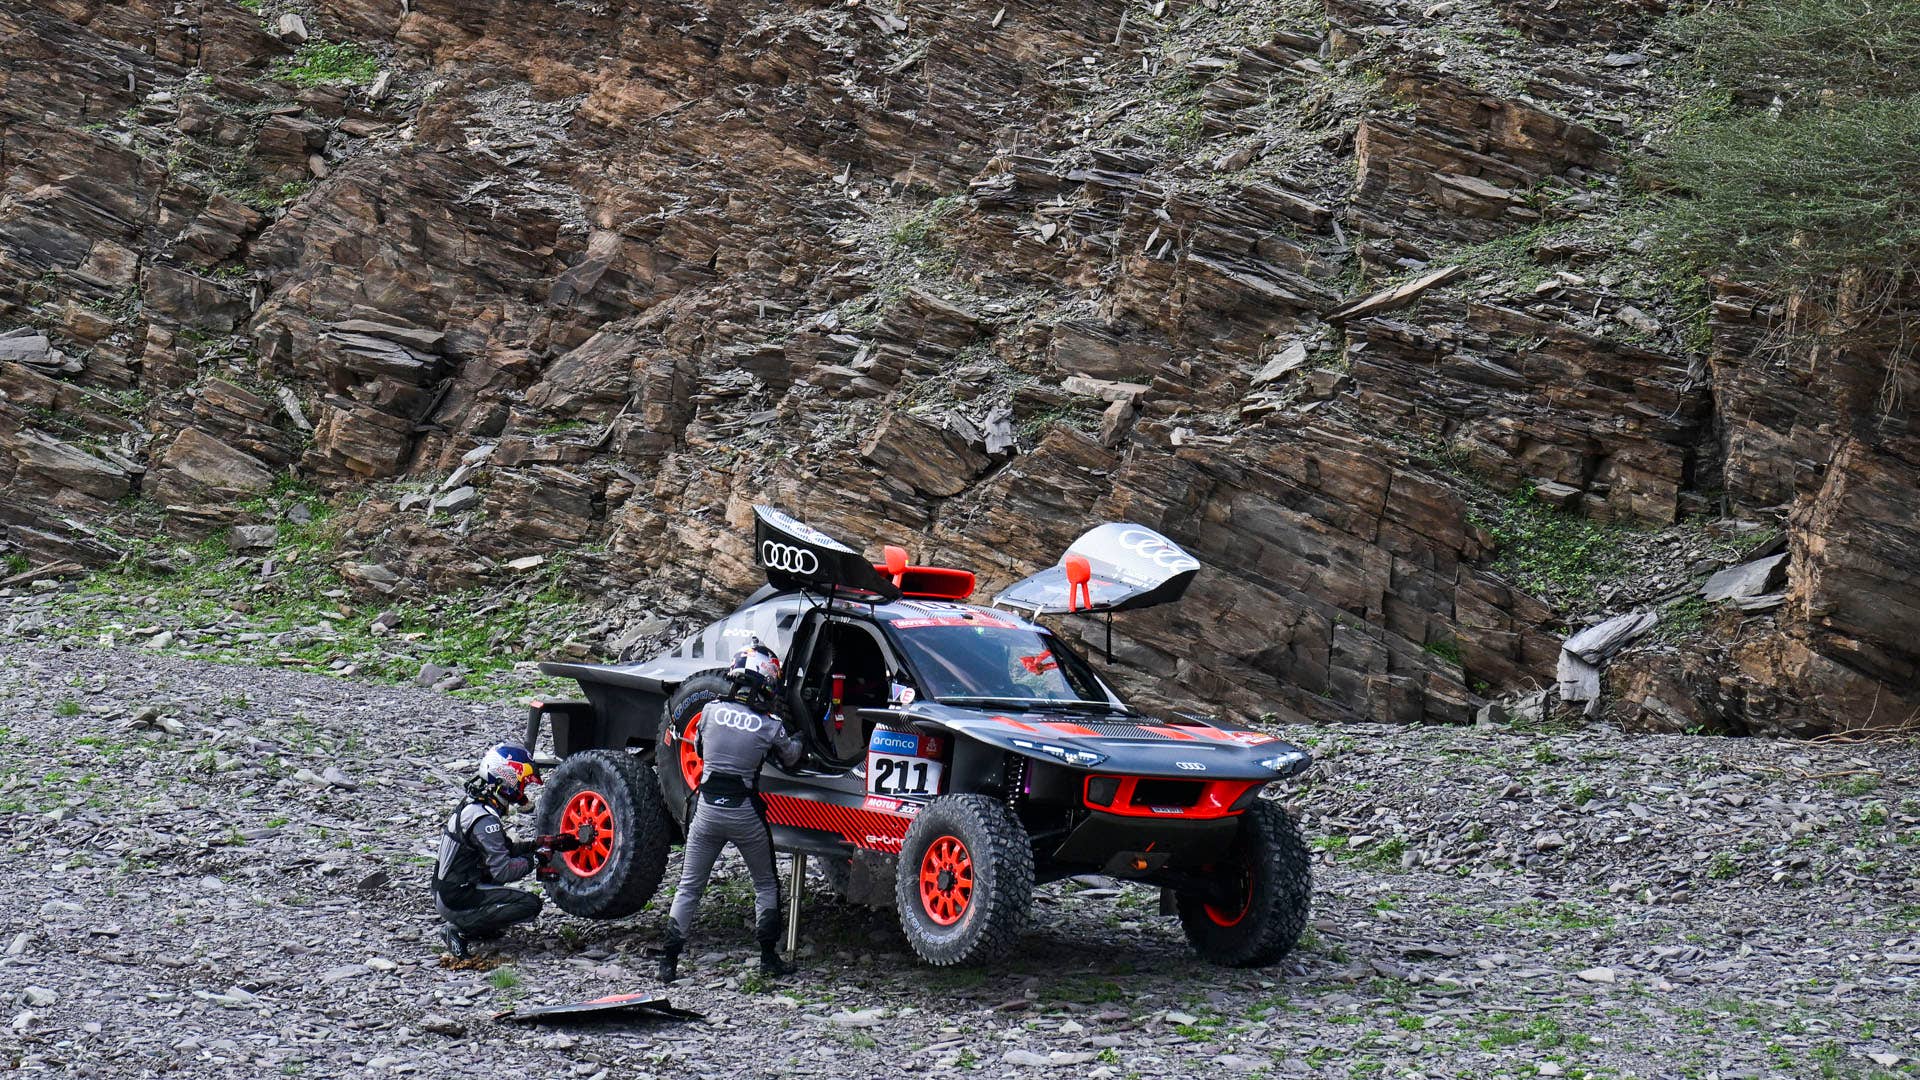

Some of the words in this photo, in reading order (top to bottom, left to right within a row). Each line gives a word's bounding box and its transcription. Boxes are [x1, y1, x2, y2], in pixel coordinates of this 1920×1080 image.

[873, 738, 915, 749] aramco
[875, 758, 929, 795] 211
[867, 798, 897, 810] MOTUL
